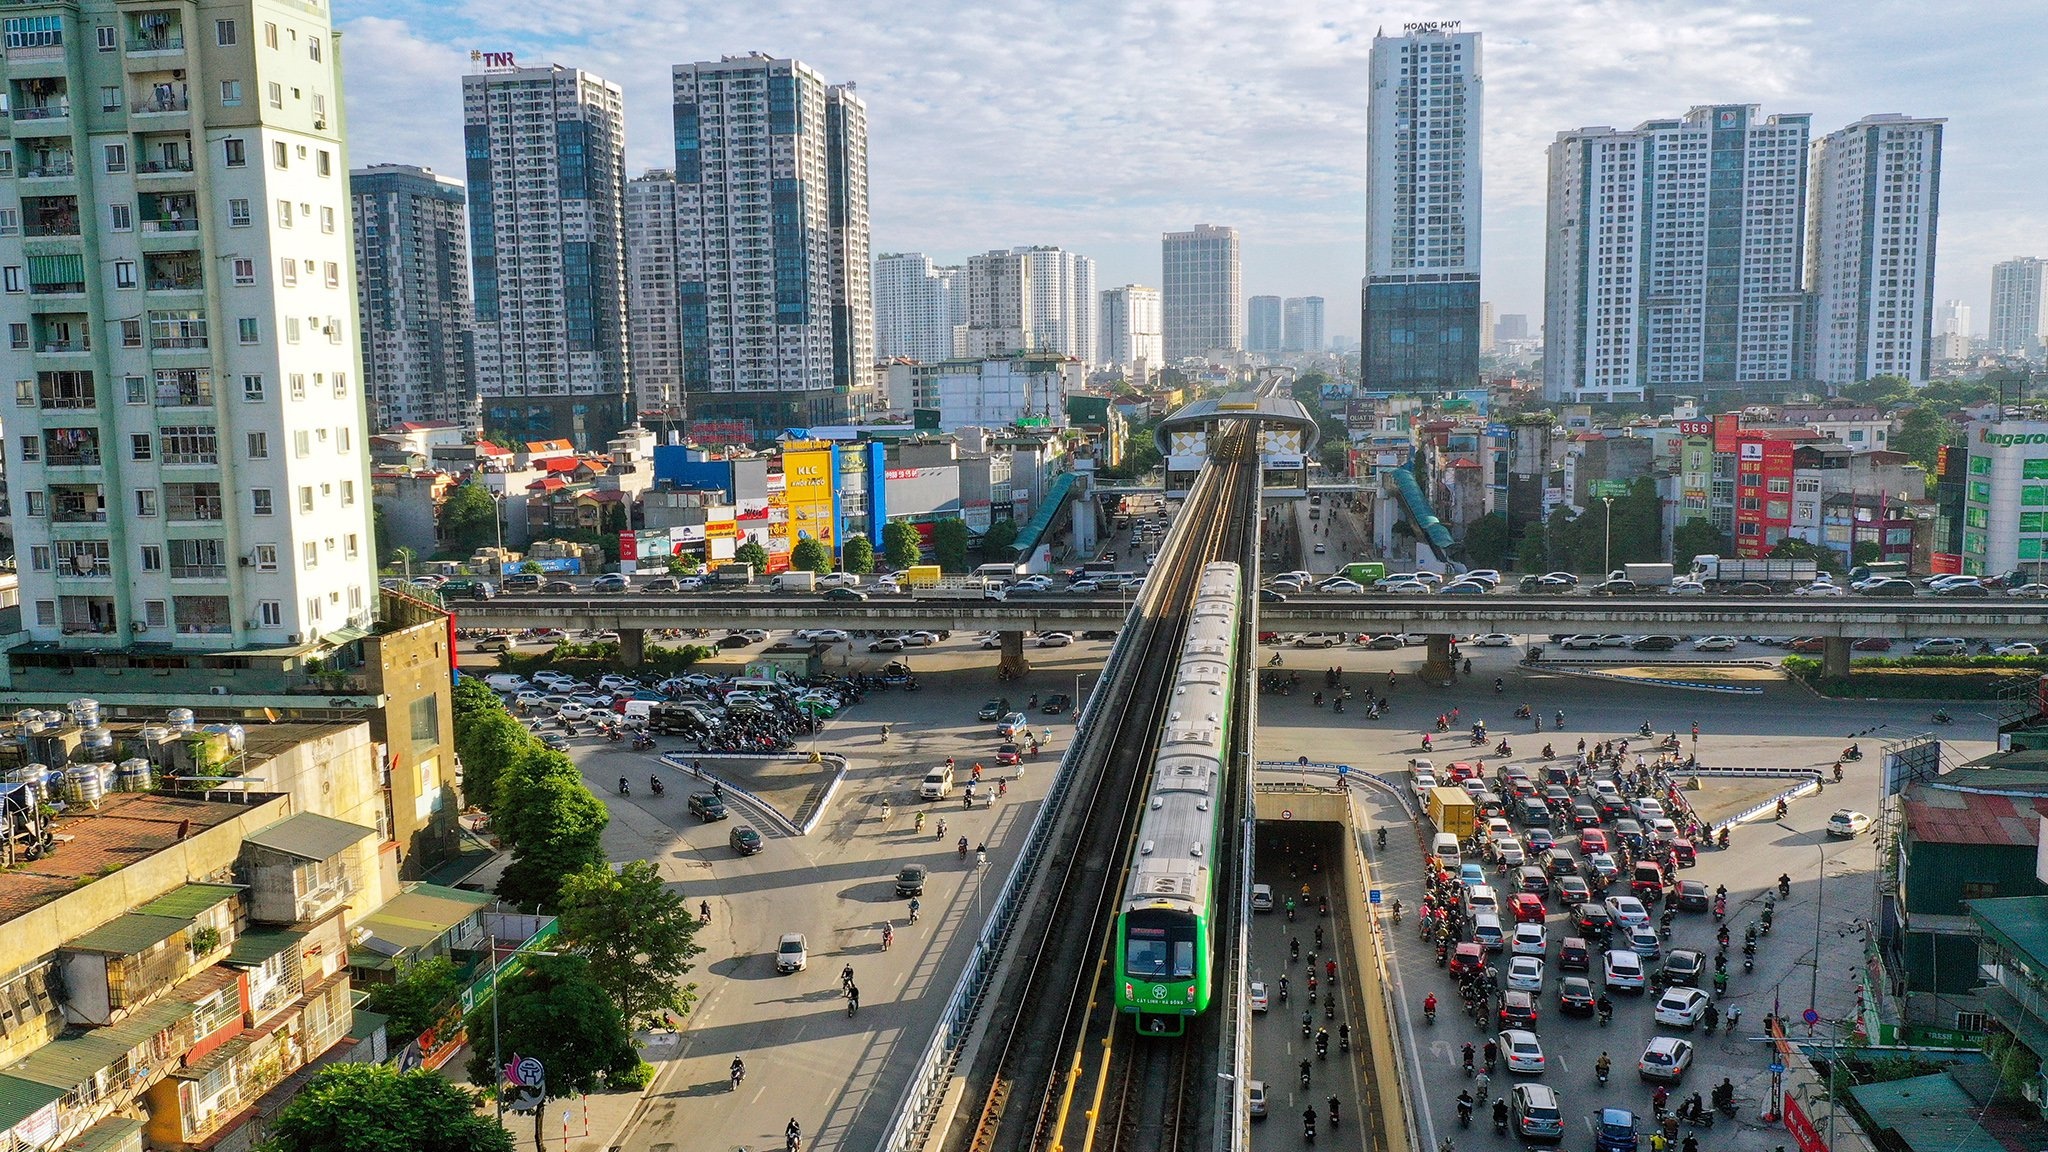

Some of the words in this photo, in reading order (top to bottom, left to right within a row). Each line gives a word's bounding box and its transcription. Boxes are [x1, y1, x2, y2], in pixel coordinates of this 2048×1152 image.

[1441, 20, 1461, 28] HUY
[483, 52, 514, 67] TNR
[1979, 427, 2048, 448] Kangaro
